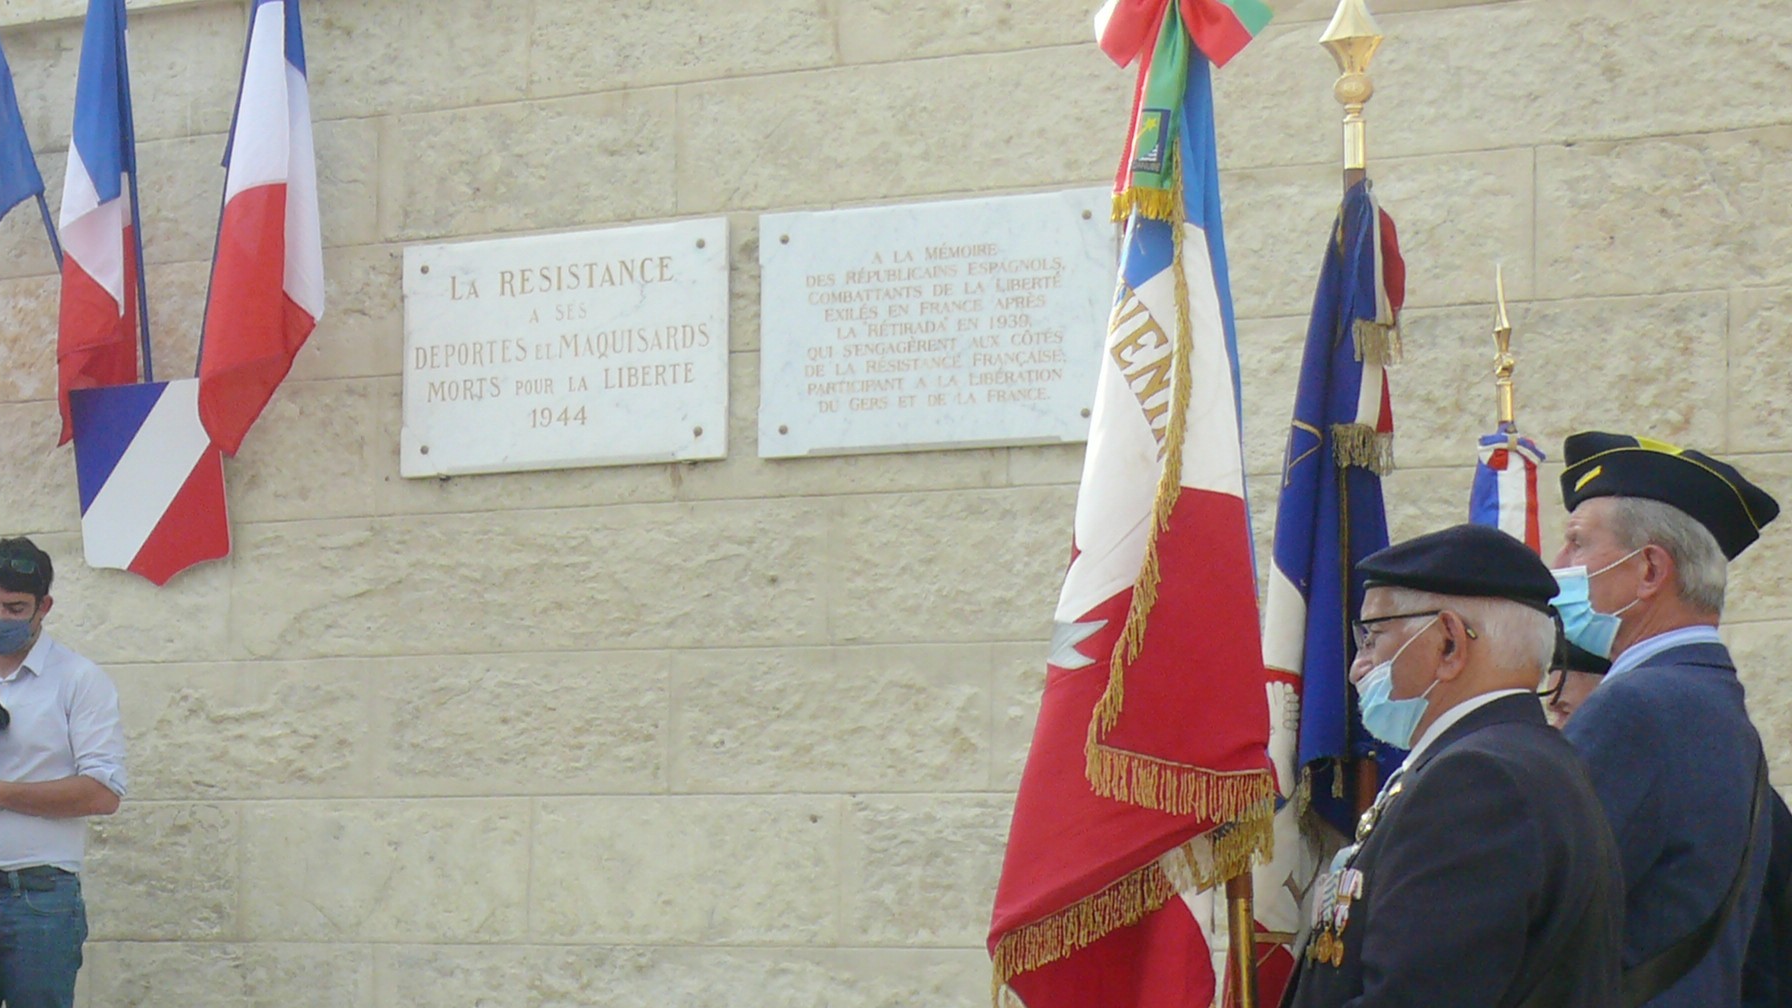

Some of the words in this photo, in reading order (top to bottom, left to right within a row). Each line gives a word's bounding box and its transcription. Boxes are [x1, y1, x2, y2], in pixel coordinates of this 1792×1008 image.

[872, 251, 883, 264] A
[893, 250, 914, 264] LA
[924, 242, 999, 261] MÉMOIRE
[450, 275, 480, 301] LA
[498, 256, 675, 298] RESISTANCE
[805, 272, 836, 288] DES
[845, 264, 958, 285] RÉPUBLICAINS
[807, 285, 923, 305] COMBATTANTS
[932, 282, 954, 297] DE
[963, 281, 985, 295] LA
[995, 271, 1062, 293] LIBERTÉ
[528, 308, 540, 324] A
[555, 303, 588, 322] SES
[824, 303, 879, 323] EXILÉS
[888, 303, 909, 318] EN
[919, 299, 984, 316] FRANCE
[995, 291, 1047, 310] APRÈS
[836, 326, 857, 341] LA
[957, 317, 979, 332] EN
[414, 337, 528, 370] DEPORTES
[558, 322, 710, 359] MAQUISARDS
[807, 345, 833, 361] QUI
[970, 335, 1000, 349] AUX
[1010, 328, 1064, 347] CÔTÉS
[804, 363, 825, 378] DE
[835, 362, 856, 376] LA
[865, 354, 963, 374] RÉSISTANCE
[1109, 281, 1172, 463] VENI
[426, 376, 502, 403] MORTS
[515, 378, 555, 396] POUR
[568, 375, 588, 393] LA
[604, 361, 695, 390] LIBERTE
[807, 377, 904, 396] PARTICIPANT
[916, 376, 927, 389] A
[937, 374, 958, 388] LA
[968, 367, 1063, 387] LIBÉRATION
[531, 405, 588, 428] 1944
[818, 400, 839, 414] DU
[848, 395, 889, 412] GERS
[897, 394, 917, 409] ET
[927, 393, 947, 408] DE
[957, 391, 977, 405] LA
